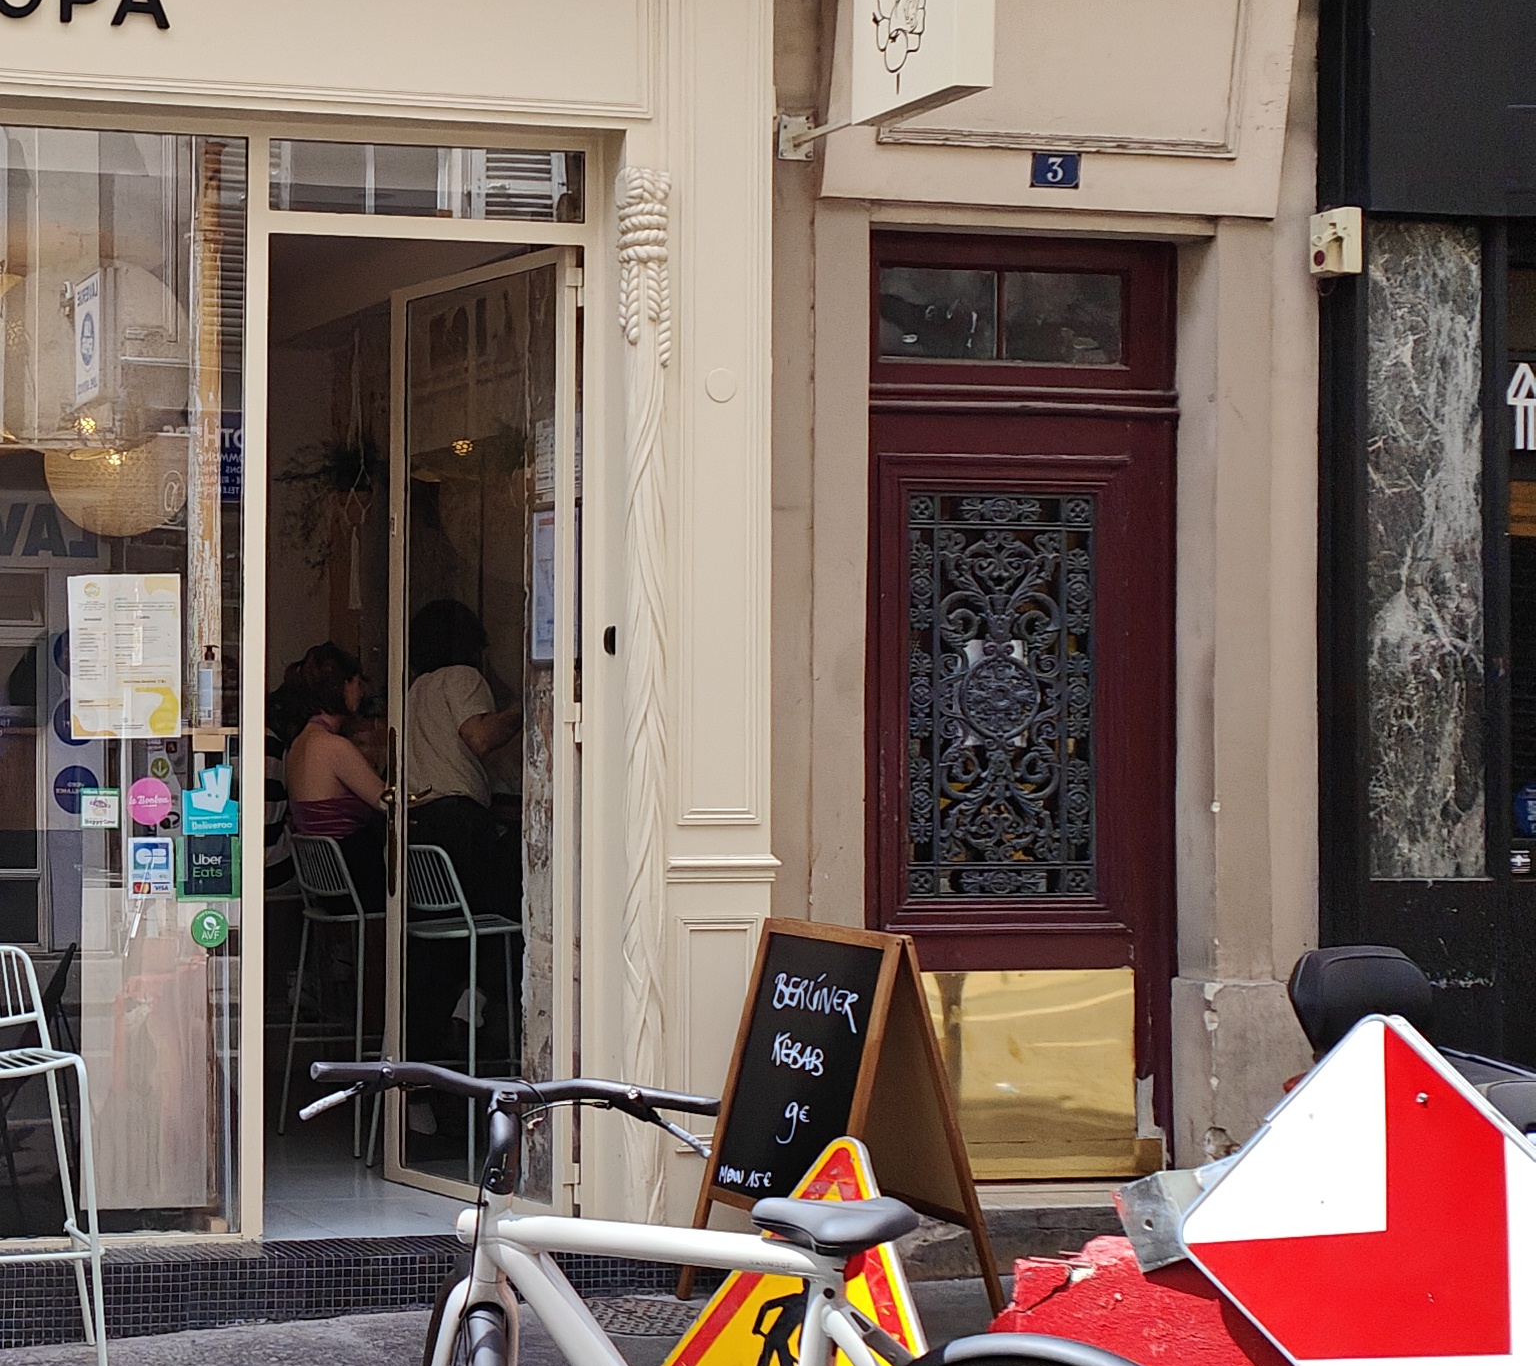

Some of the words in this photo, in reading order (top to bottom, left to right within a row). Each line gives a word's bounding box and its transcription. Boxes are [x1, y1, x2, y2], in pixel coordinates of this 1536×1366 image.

[1046, 156, 1064, 183] 3
[191, 821, 233, 830] Deliveroo
[192, 853, 222, 866] Uber
[193, 867, 223, 878] Eats
[201, 931, 220, 940] AVF
[771, 1032, 824, 1076] KEBAB
[775, 1101, 810, 1144] 9€
[719, 1165, 744, 1184] MENU
[745, 1170, 772, 1188] 15€
